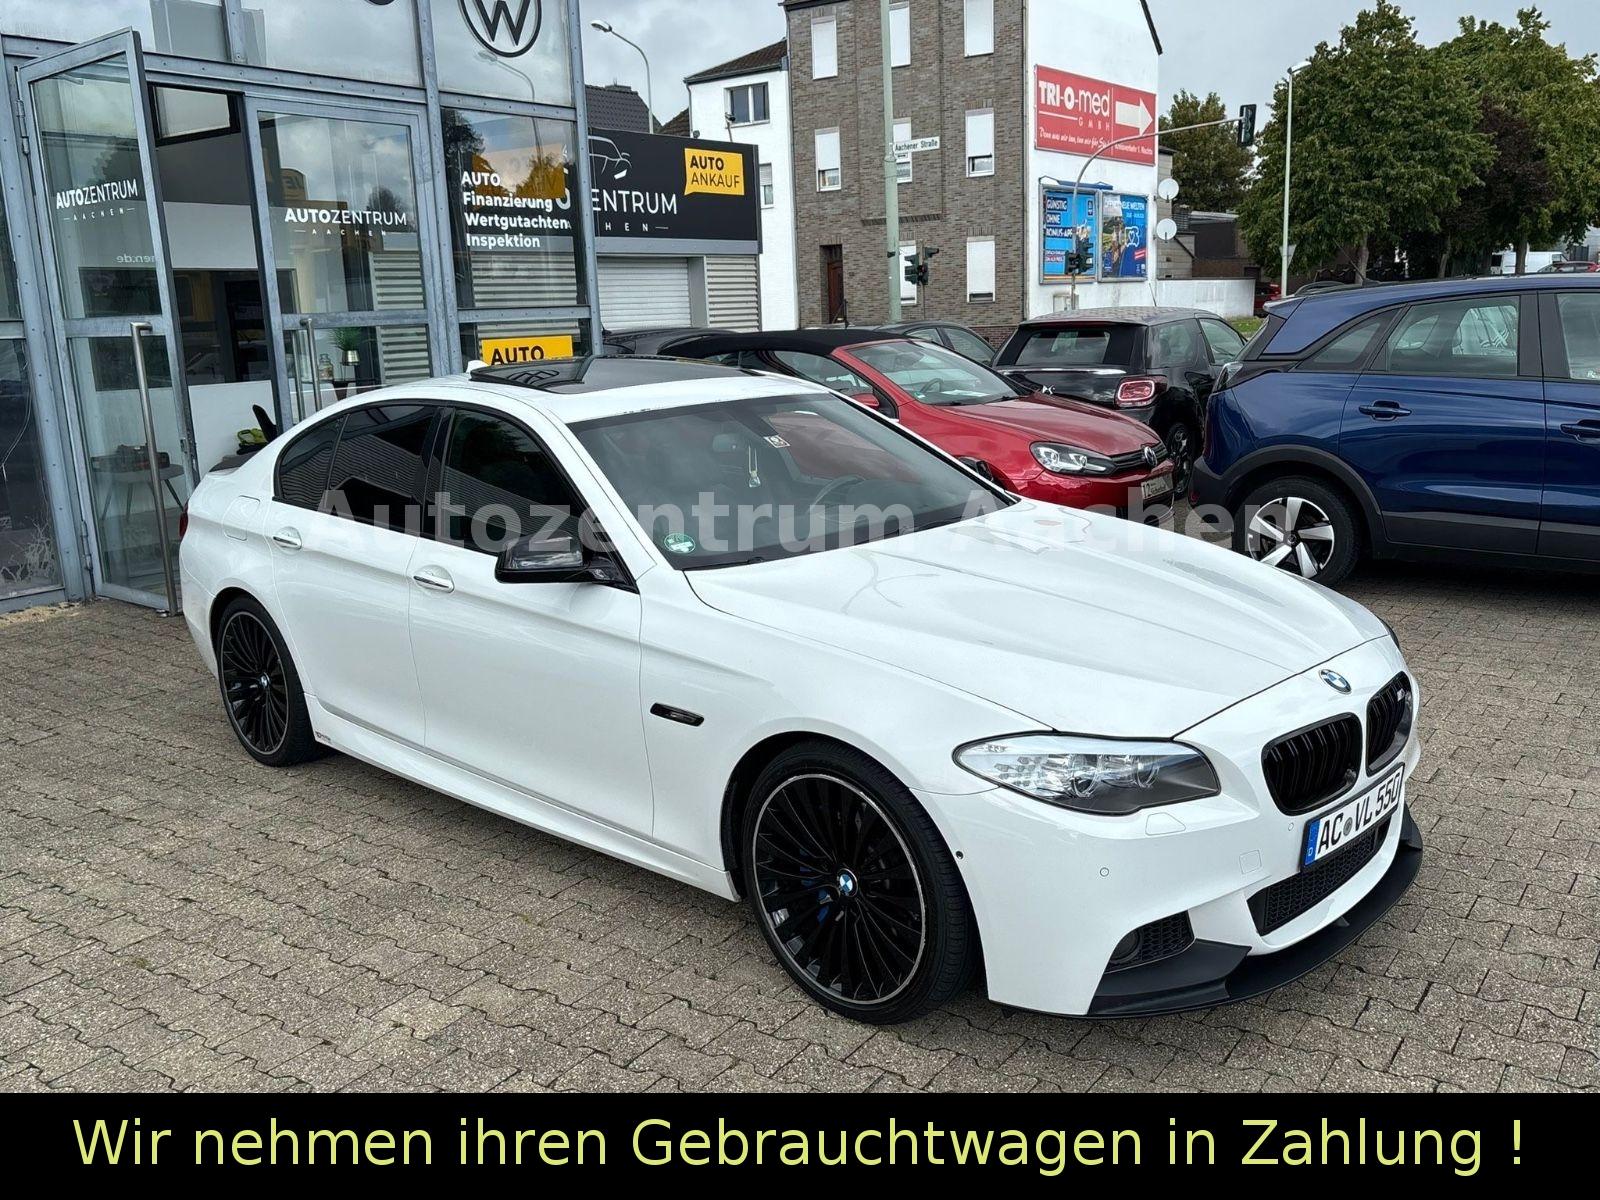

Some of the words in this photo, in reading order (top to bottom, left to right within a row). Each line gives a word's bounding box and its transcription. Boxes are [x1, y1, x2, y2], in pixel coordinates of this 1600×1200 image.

[1039, 80, 1110, 117] TRI-O-med
[895, 143, 918, 151] Aachener
[920, 139, 938, 148] Straße
[690, 155, 724, 171] AUTO
[461, 171, 501, 187] AUTO
[691, 172, 740, 188] ANKAUF
[56, 179, 138, 210] AUTOZENTRUM
[463, 191, 553, 213] Finanzierung
[73, 208, 124, 221] AACHEN
[284, 208, 407, 226] AUTOZENTRUM
[464, 212, 569, 231] Wertgutachten
[312, 229, 387, 237] AACHEN
[466, 233, 541, 250] Inspektion
[491, 345, 545, 365] AUTO
[1318, 812, 1344, 854] AC
[1355, 796, 1373, 832] VL
[1375, 772, 1400, 817] 550
